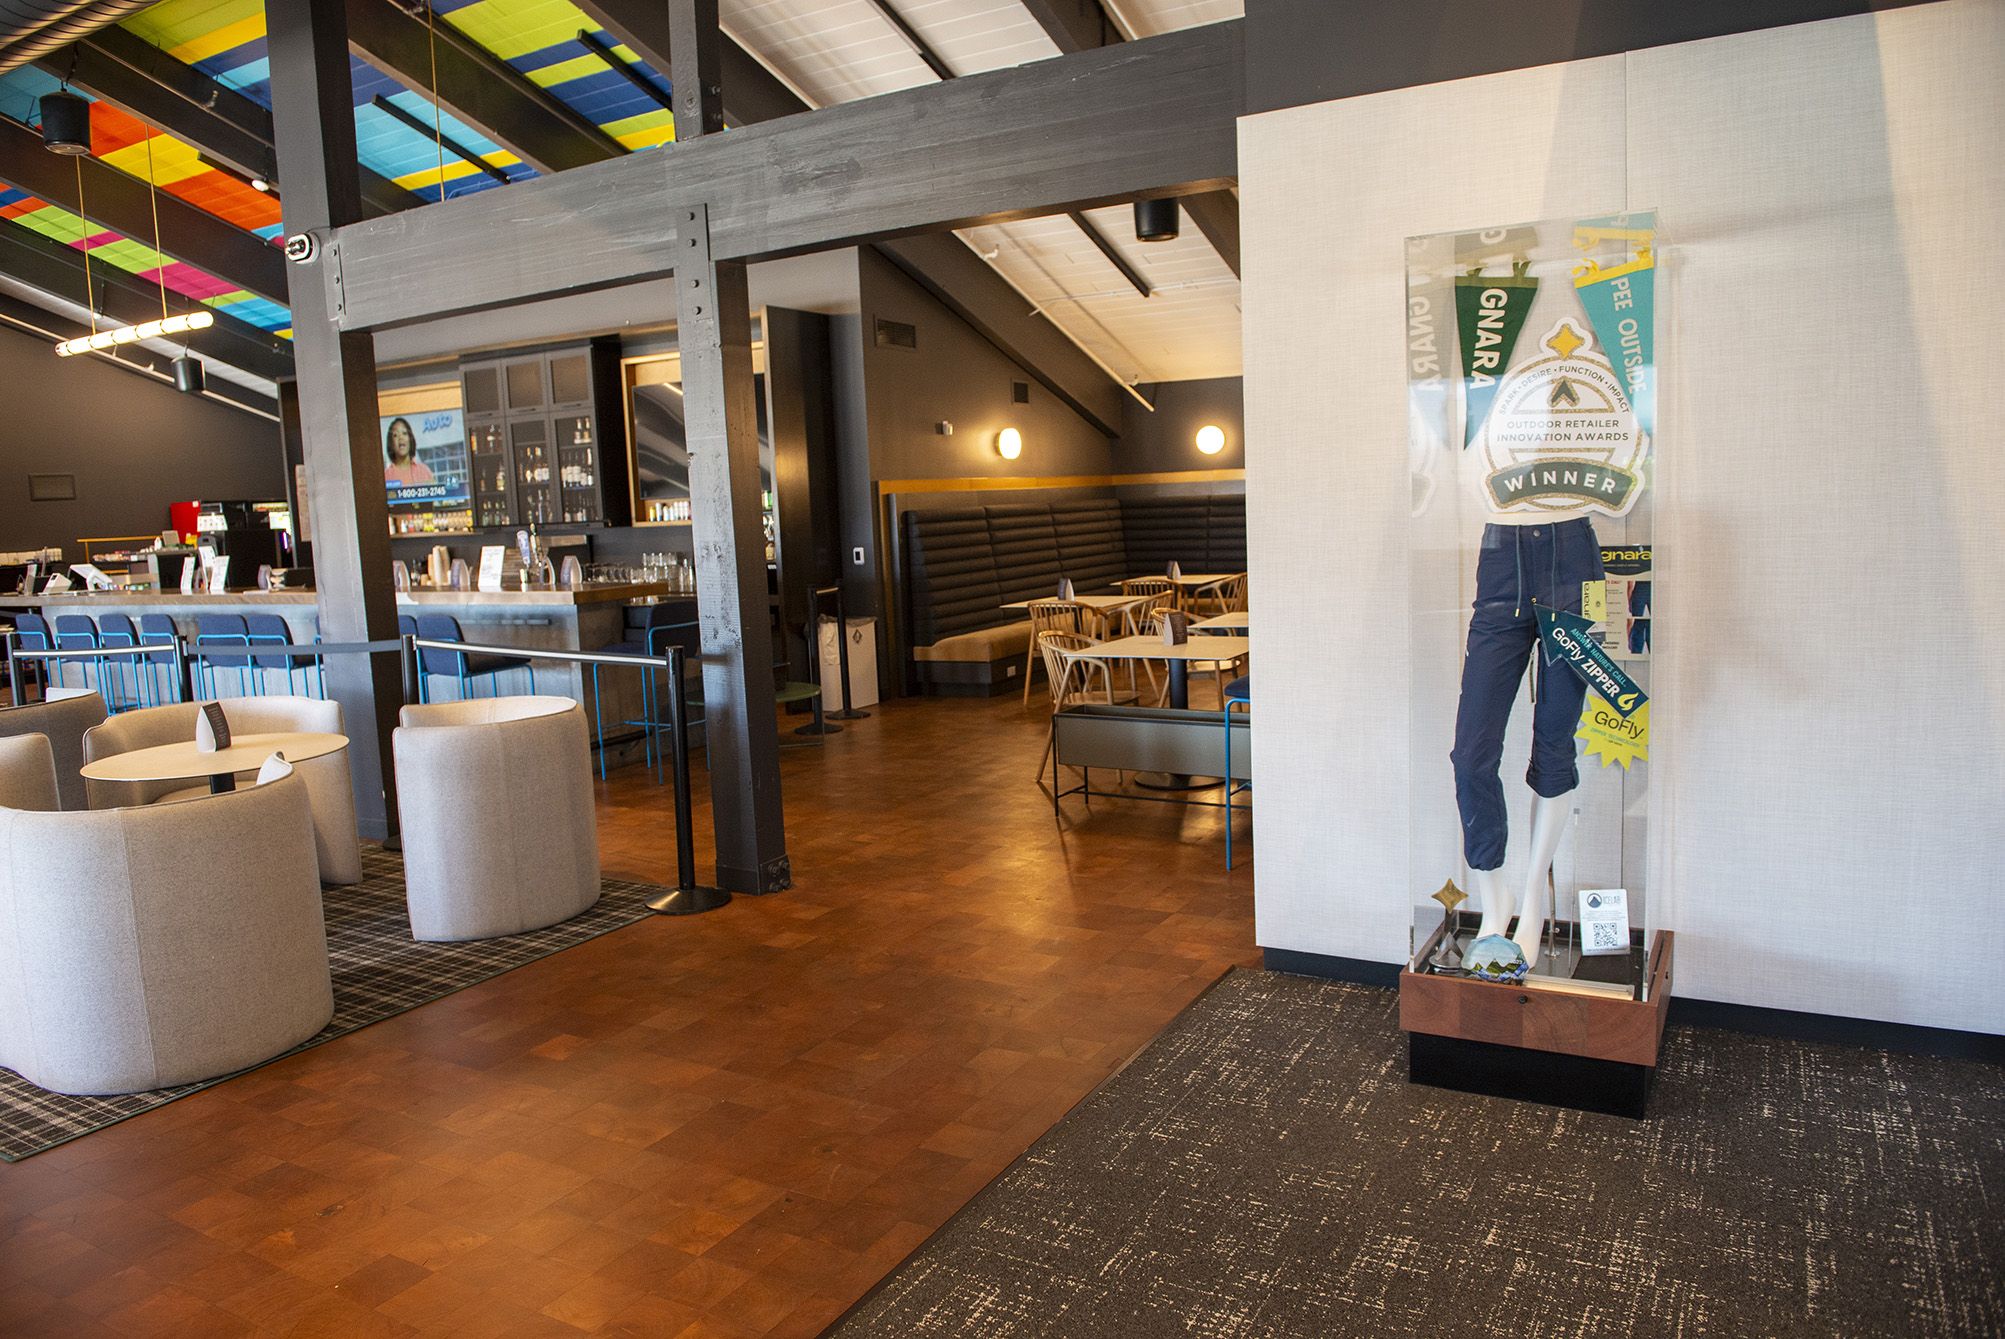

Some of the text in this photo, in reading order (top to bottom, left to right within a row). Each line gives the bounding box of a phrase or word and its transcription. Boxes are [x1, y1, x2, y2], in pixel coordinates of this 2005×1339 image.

[1470, 288, 1508, 389] GNARA
[1610, 277, 1647, 394] PEE OUTSIDE
[1498, 365, 1630, 416] SPARK DESIRE FUNCTION IMPACT
[1497, 432, 1629, 442] INNOVATION AWARDS
[1507, 419, 1619, 429] OUTDOOR RETAILER
[1504, 471, 1617, 494] WINNER
[1600, 550, 1651, 562] gnara
[1552, 627, 1584, 661] GoFly
[1581, 659, 1620, 698] ZIPPER
[1570, 628, 1593, 649] ANSWER
[1590, 647, 1615, 673] NATURE'S
[1594, 711, 1645, 739] GoFly
